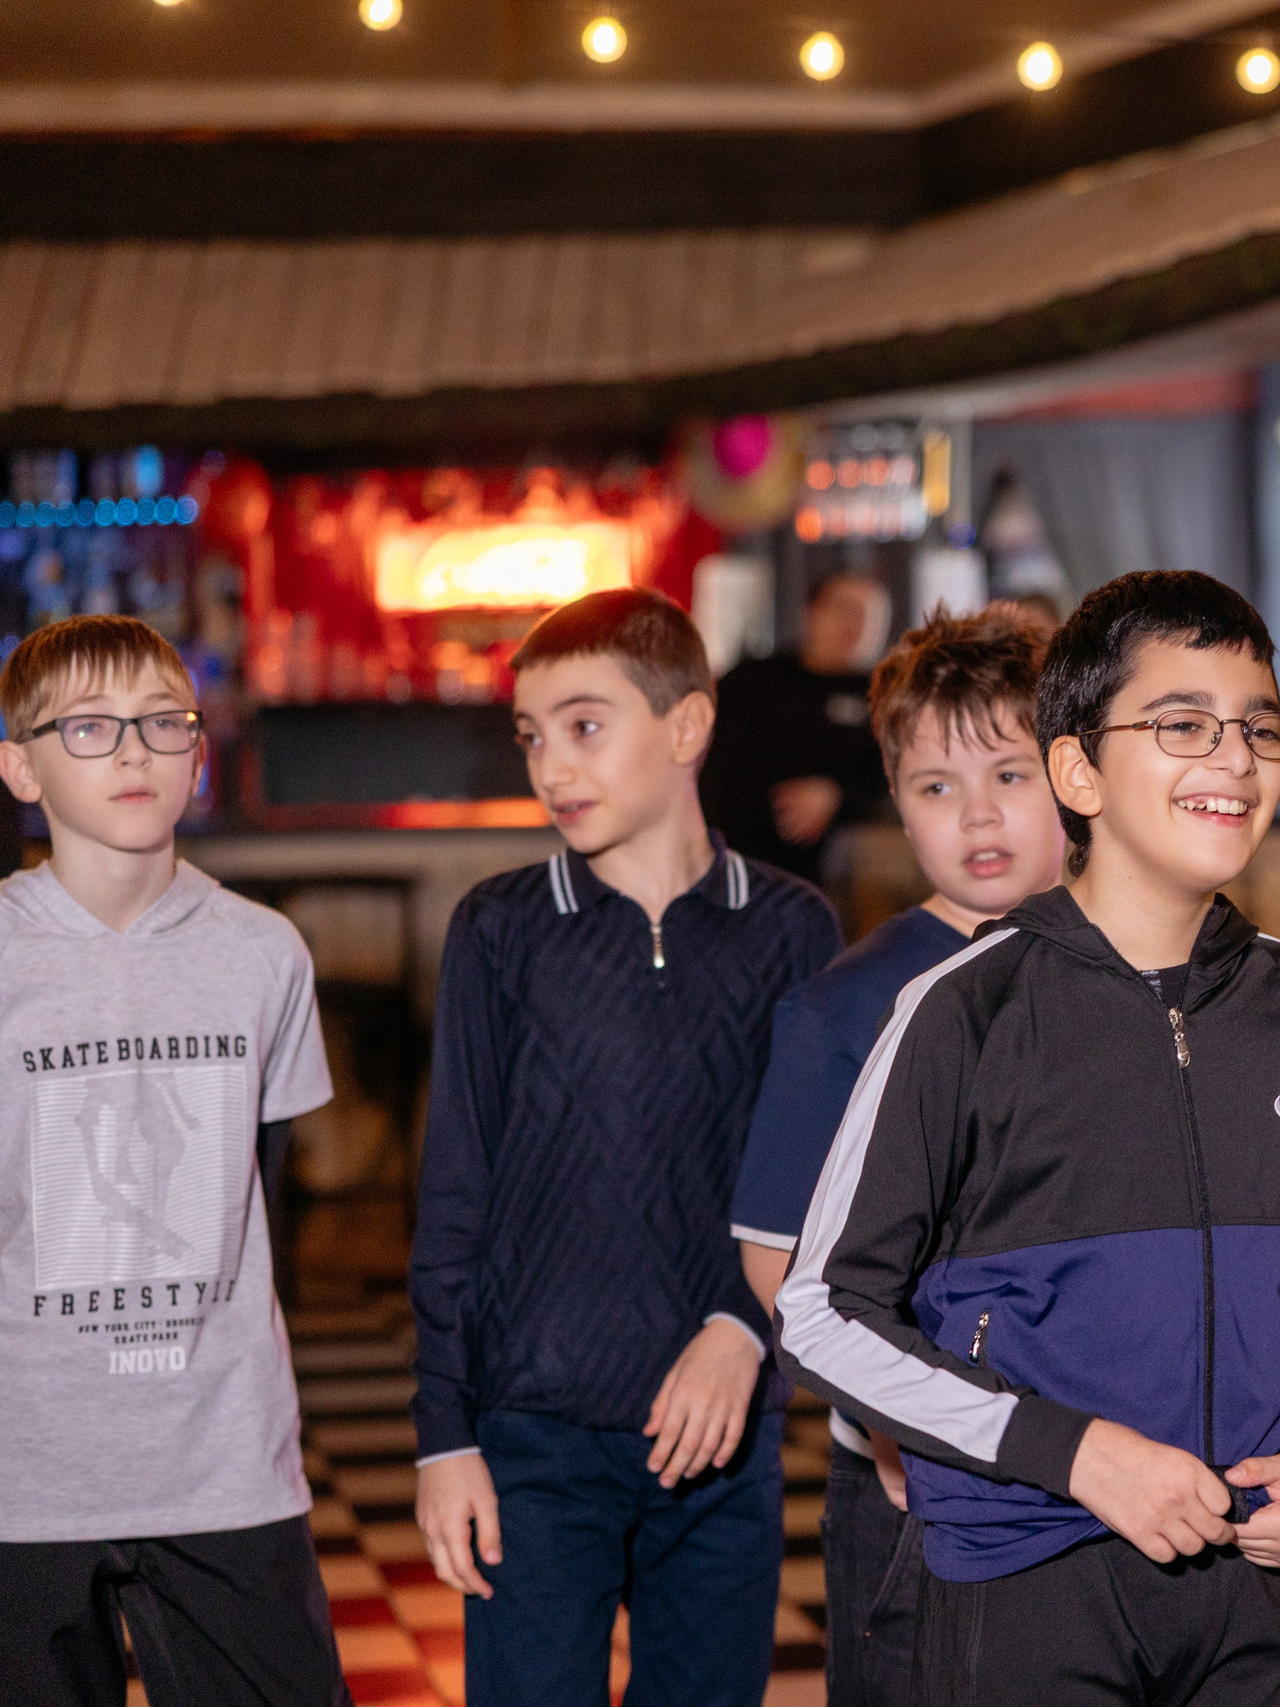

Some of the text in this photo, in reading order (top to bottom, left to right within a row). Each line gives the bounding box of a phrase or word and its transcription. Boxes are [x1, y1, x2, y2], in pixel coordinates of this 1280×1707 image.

[23, 1034, 247, 1073] SKATEBOARDING
[104, 1321, 130, 1333] YORK
[134, 1320, 156, 1331] CITY
[114, 1331, 179, 1345] SKATE PARK
[108, 1345, 187, 1375] INOVO
